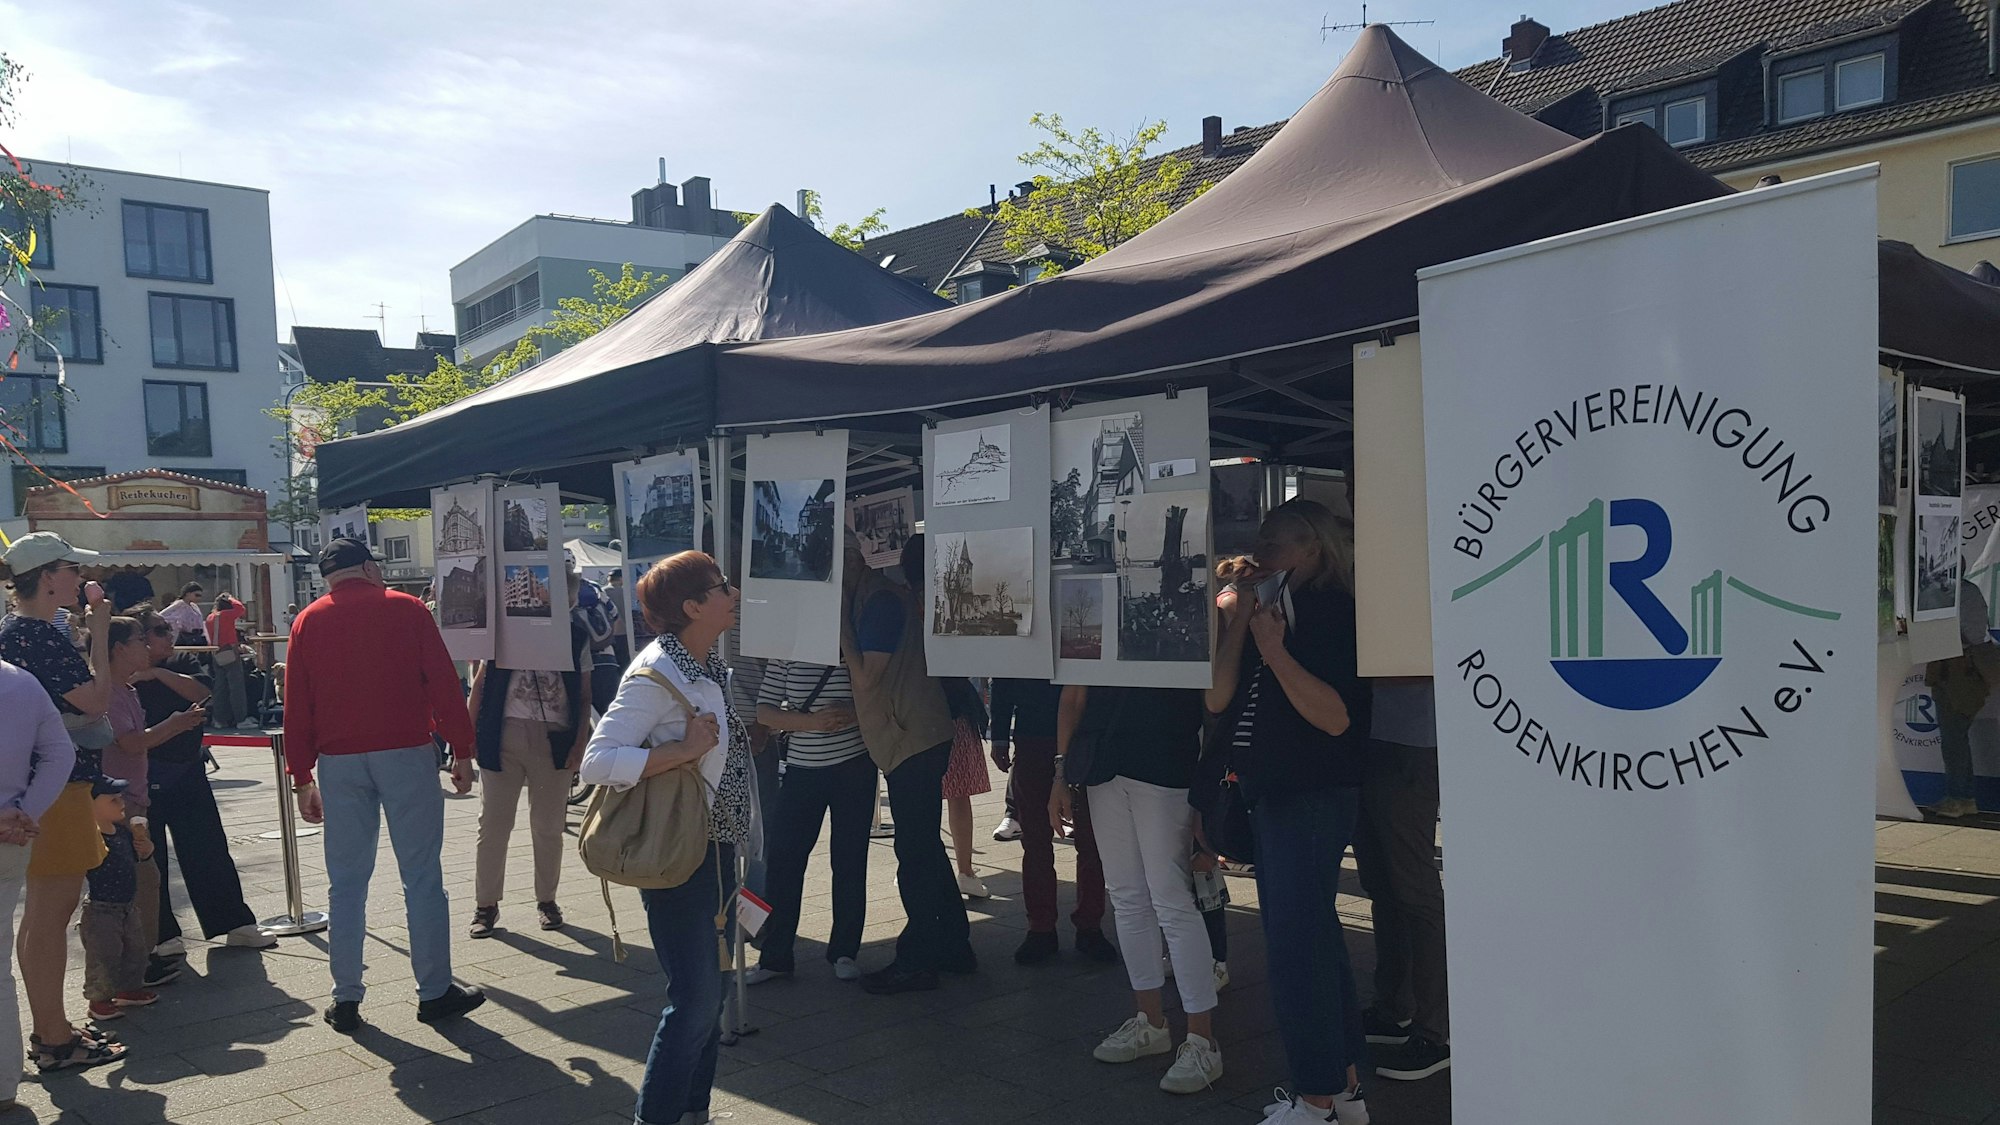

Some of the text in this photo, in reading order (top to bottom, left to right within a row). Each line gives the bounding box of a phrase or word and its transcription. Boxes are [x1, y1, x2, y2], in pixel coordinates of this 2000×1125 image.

[1453, 384, 1830, 560] BÜRGERVEREINIGUNG
[1961, 500, 2000, 546] GER
[1609, 498, 1689, 656] R
[1457, 638, 1834, 792] RODENKIRCHEN e.V.
[1893, 729, 1943, 747] DENKIRCHE
